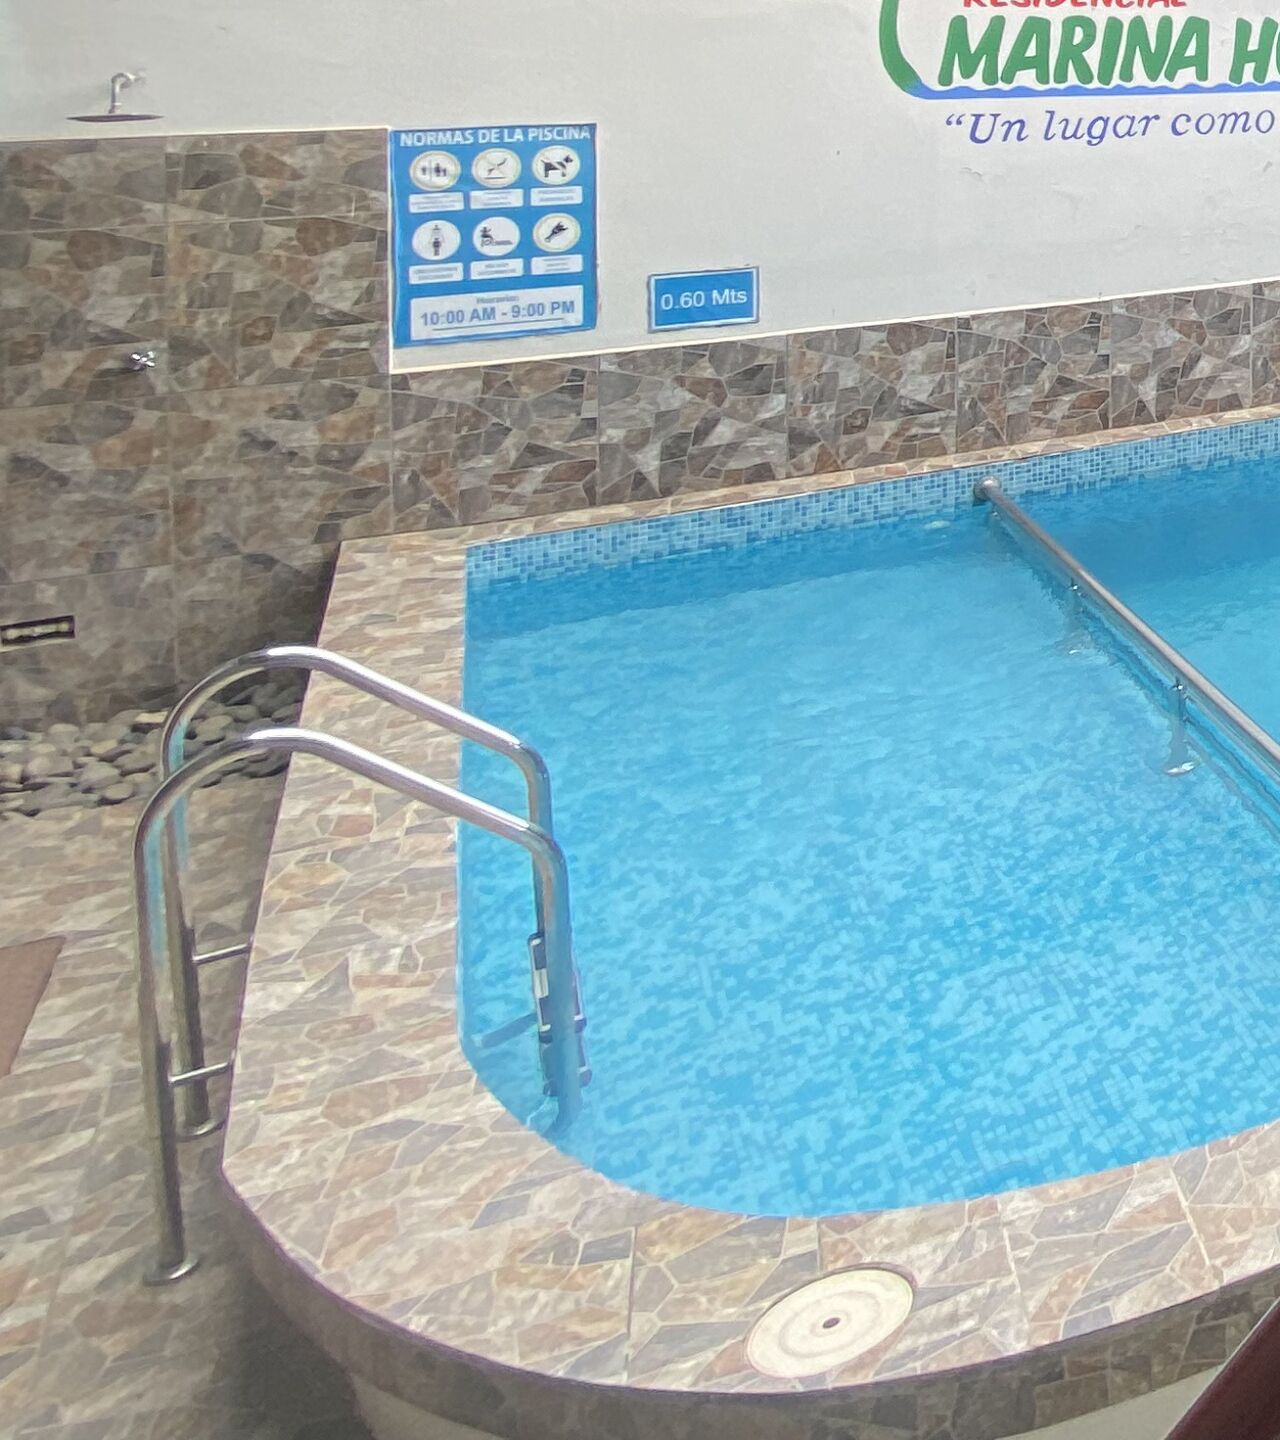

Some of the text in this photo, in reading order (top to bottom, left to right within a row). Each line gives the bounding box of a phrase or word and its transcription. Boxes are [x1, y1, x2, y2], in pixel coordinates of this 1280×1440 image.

[938, 15, 1210, 86] MARINA
[400, 125, 592, 147] NORMAS DE LA PISCINA
[1043, 110, 1160, 147] lugar
[1170, 109, 1275, 137] como
[660, 288, 748, 311] 0.60 Mts
[420, 309, 465, 327] 10:00
[469, 306, 496, 323] AM
[511, 303, 546, 320] 9:00
[550, 300, 576, 315] PM
